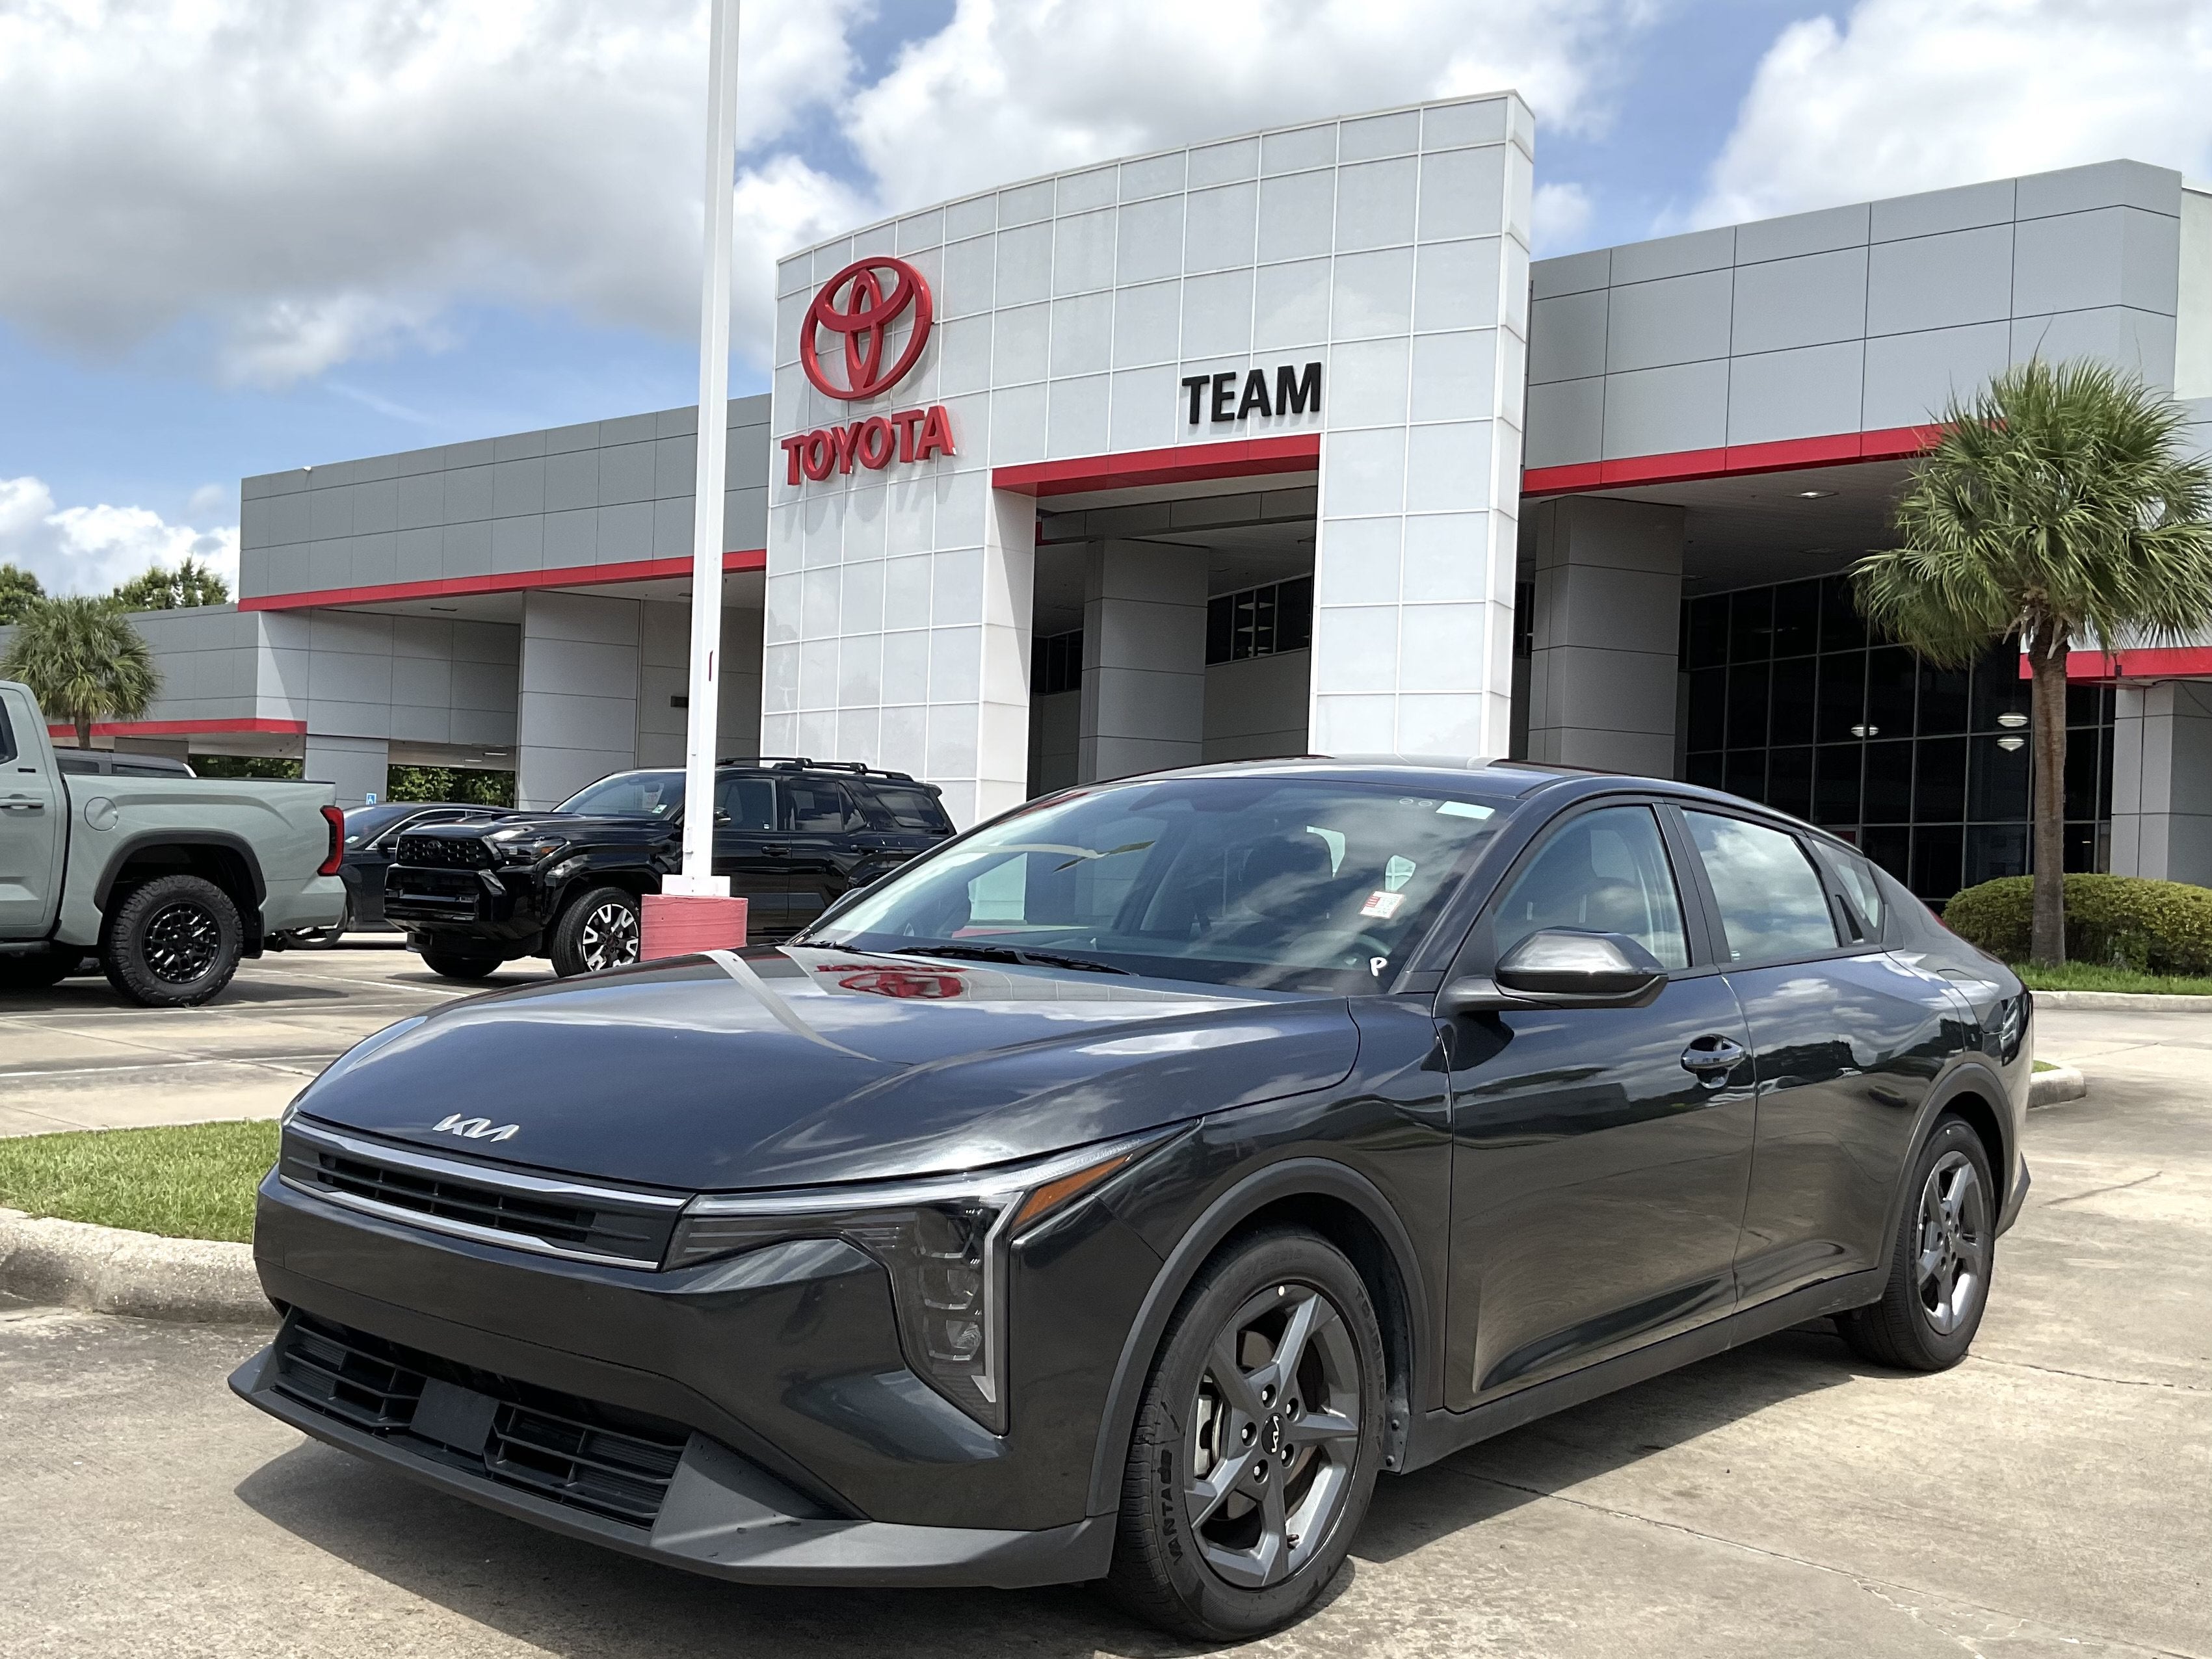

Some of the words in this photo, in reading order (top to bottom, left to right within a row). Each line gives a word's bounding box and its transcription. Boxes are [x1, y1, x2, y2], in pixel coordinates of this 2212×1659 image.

[1181, 362, 1321, 424] TEAM
[781, 405, 956, 485] TOYOTA
[1370, 957, 1388, 976] P
[432, 1113, 520, 1143] KIA
